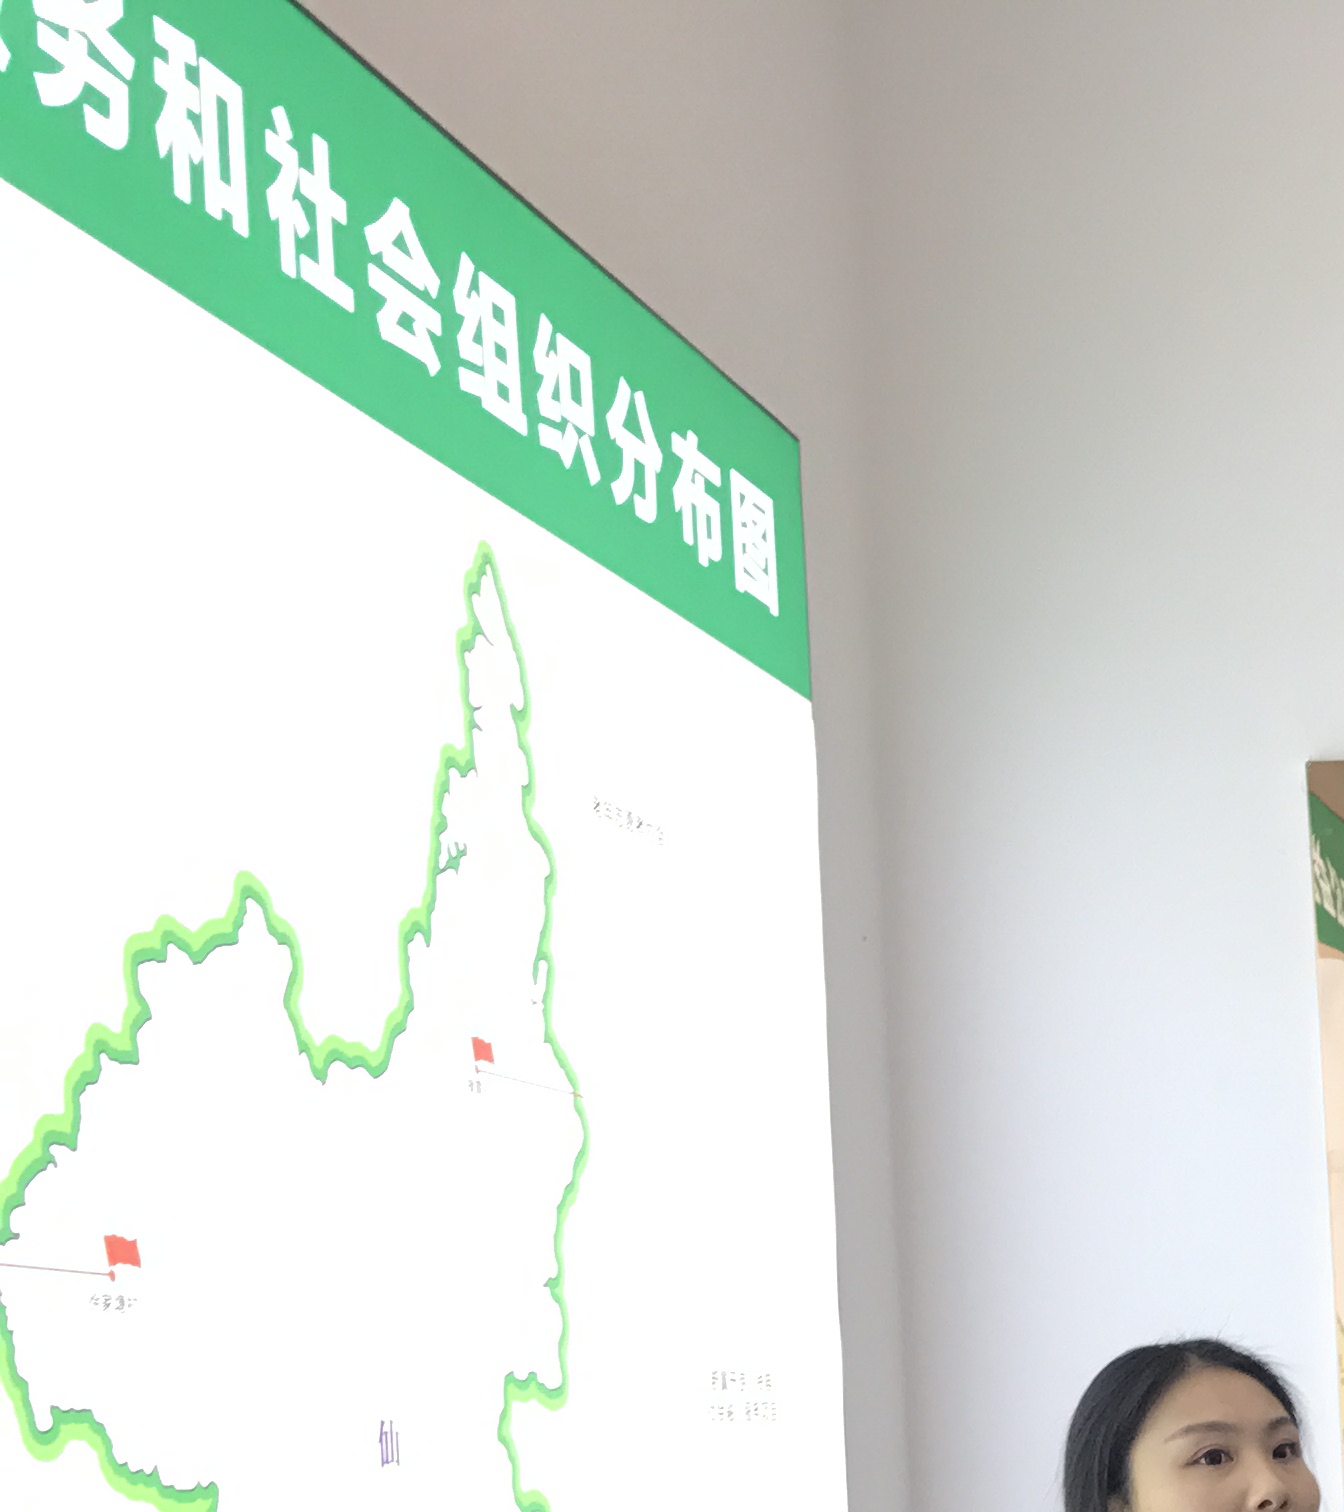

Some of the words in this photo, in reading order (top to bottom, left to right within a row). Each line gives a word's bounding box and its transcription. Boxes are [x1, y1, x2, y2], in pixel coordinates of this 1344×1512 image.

[0, 0, 780, 617] 务和社会组织分布图
